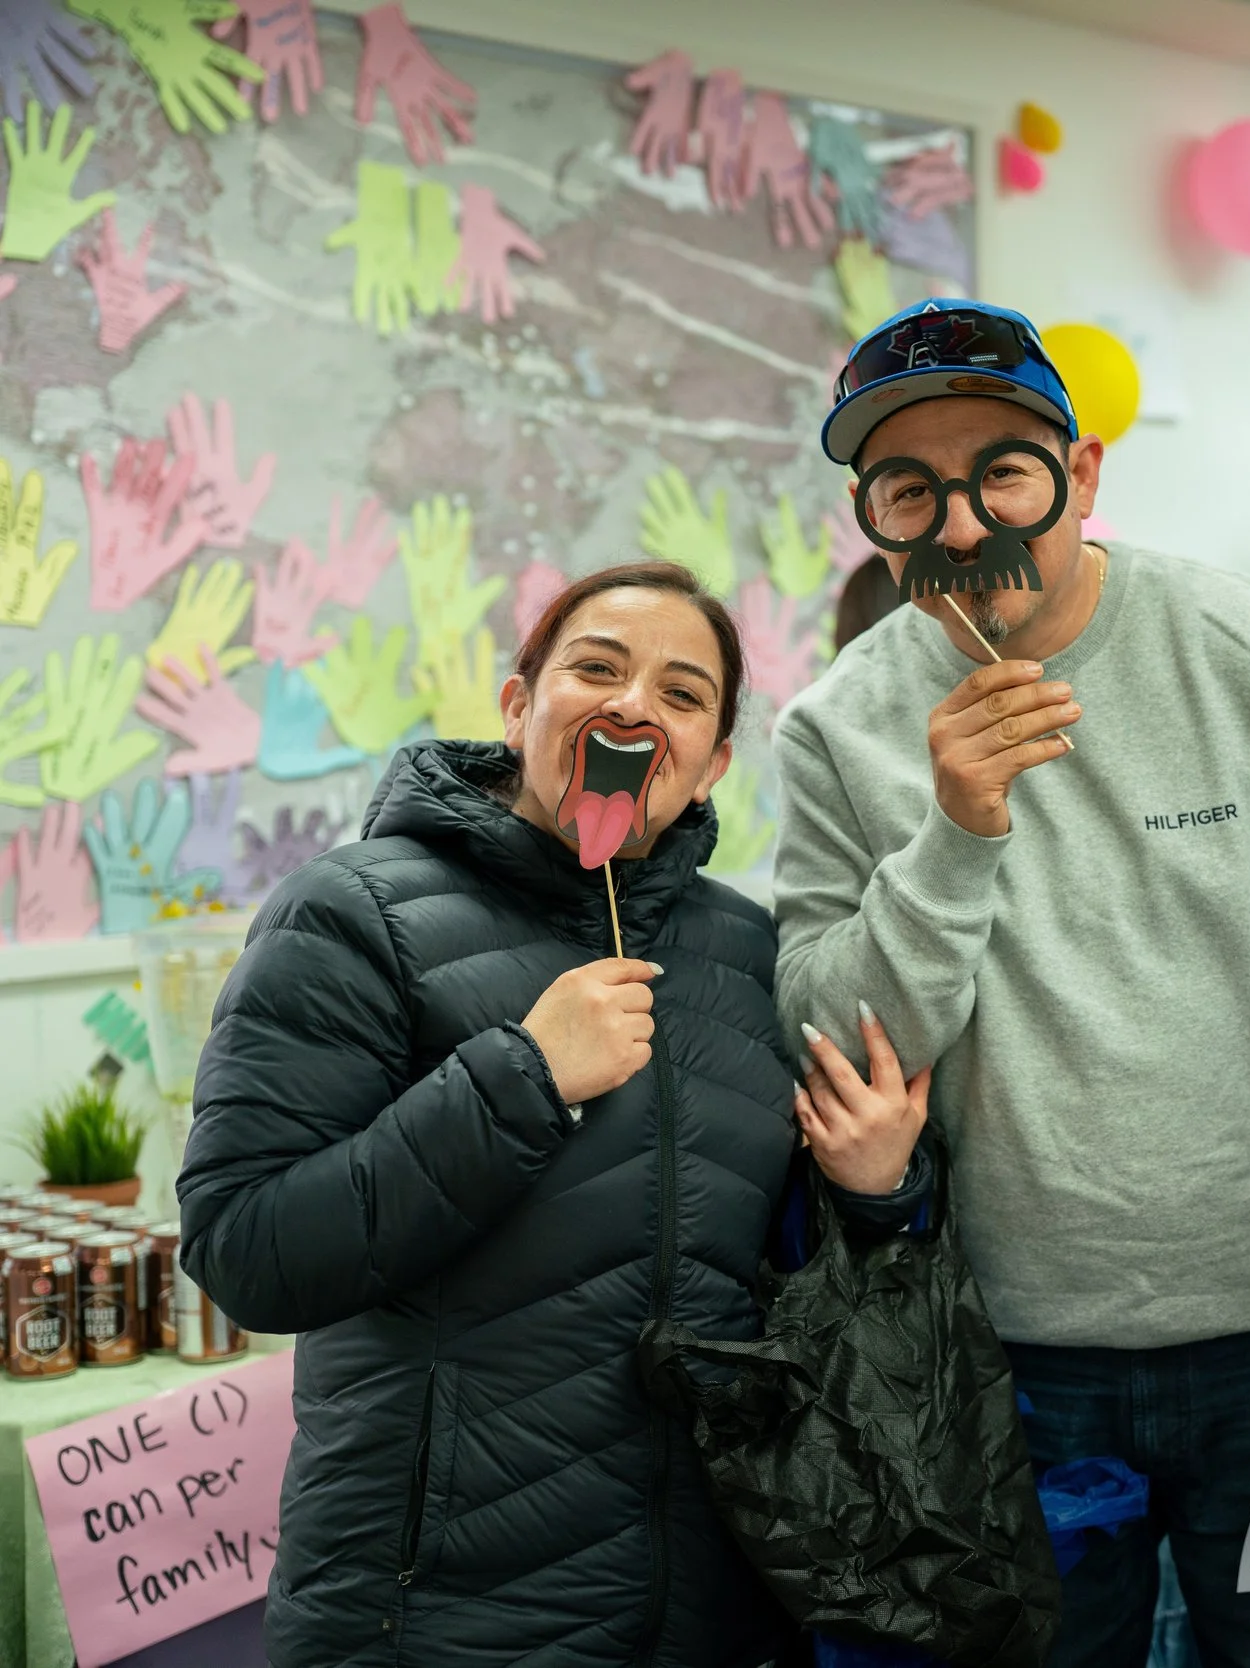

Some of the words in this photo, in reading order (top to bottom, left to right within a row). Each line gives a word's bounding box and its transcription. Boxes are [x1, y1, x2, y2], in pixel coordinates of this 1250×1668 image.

[1144, 803, 1239, 831] HILFIGER
[26, 1317, 60, 1336] ROOT
[57, 1412, 168, 1486] ONE
[190, 1380, 248, 1436] (1)
[83, 1487, 164, 1543] can
[176, 1457, 244, 1518] per
[116, 1529, 254, 1615] family
